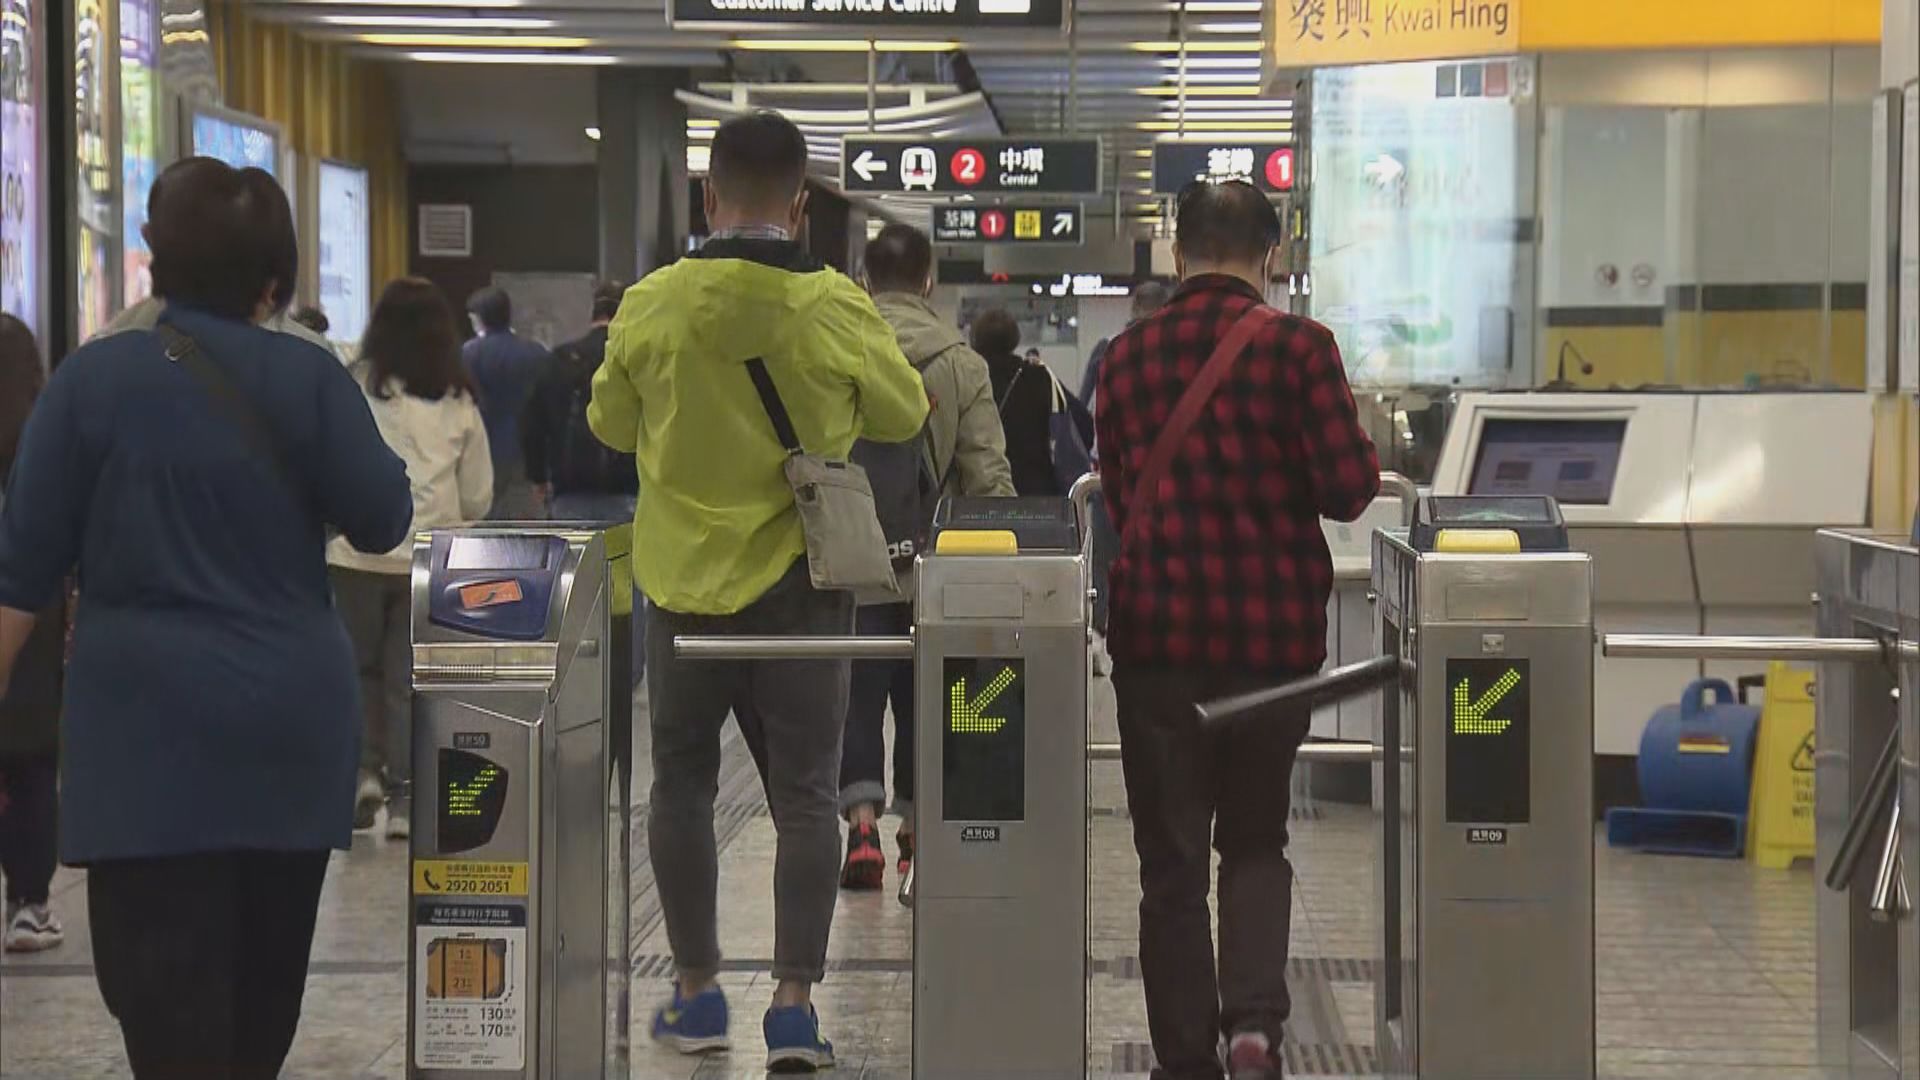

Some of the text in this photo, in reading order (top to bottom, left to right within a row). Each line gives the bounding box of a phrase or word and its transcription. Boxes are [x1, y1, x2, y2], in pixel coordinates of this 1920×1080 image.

[1384, 0, 1441, 34] Kwai
[1451, 0, 1508, 36] Hing
[960, 153, 976, 179] 2
[1278, 155, 1290, 181] 1
[999, 172, 1038, 186] Central
[987, 213, 997, 236] 1
[446, 881, 509, 893] 2920 2051
[480, 1007, 503, 1021] 130
[480, 1023, 503, 1037] 170
